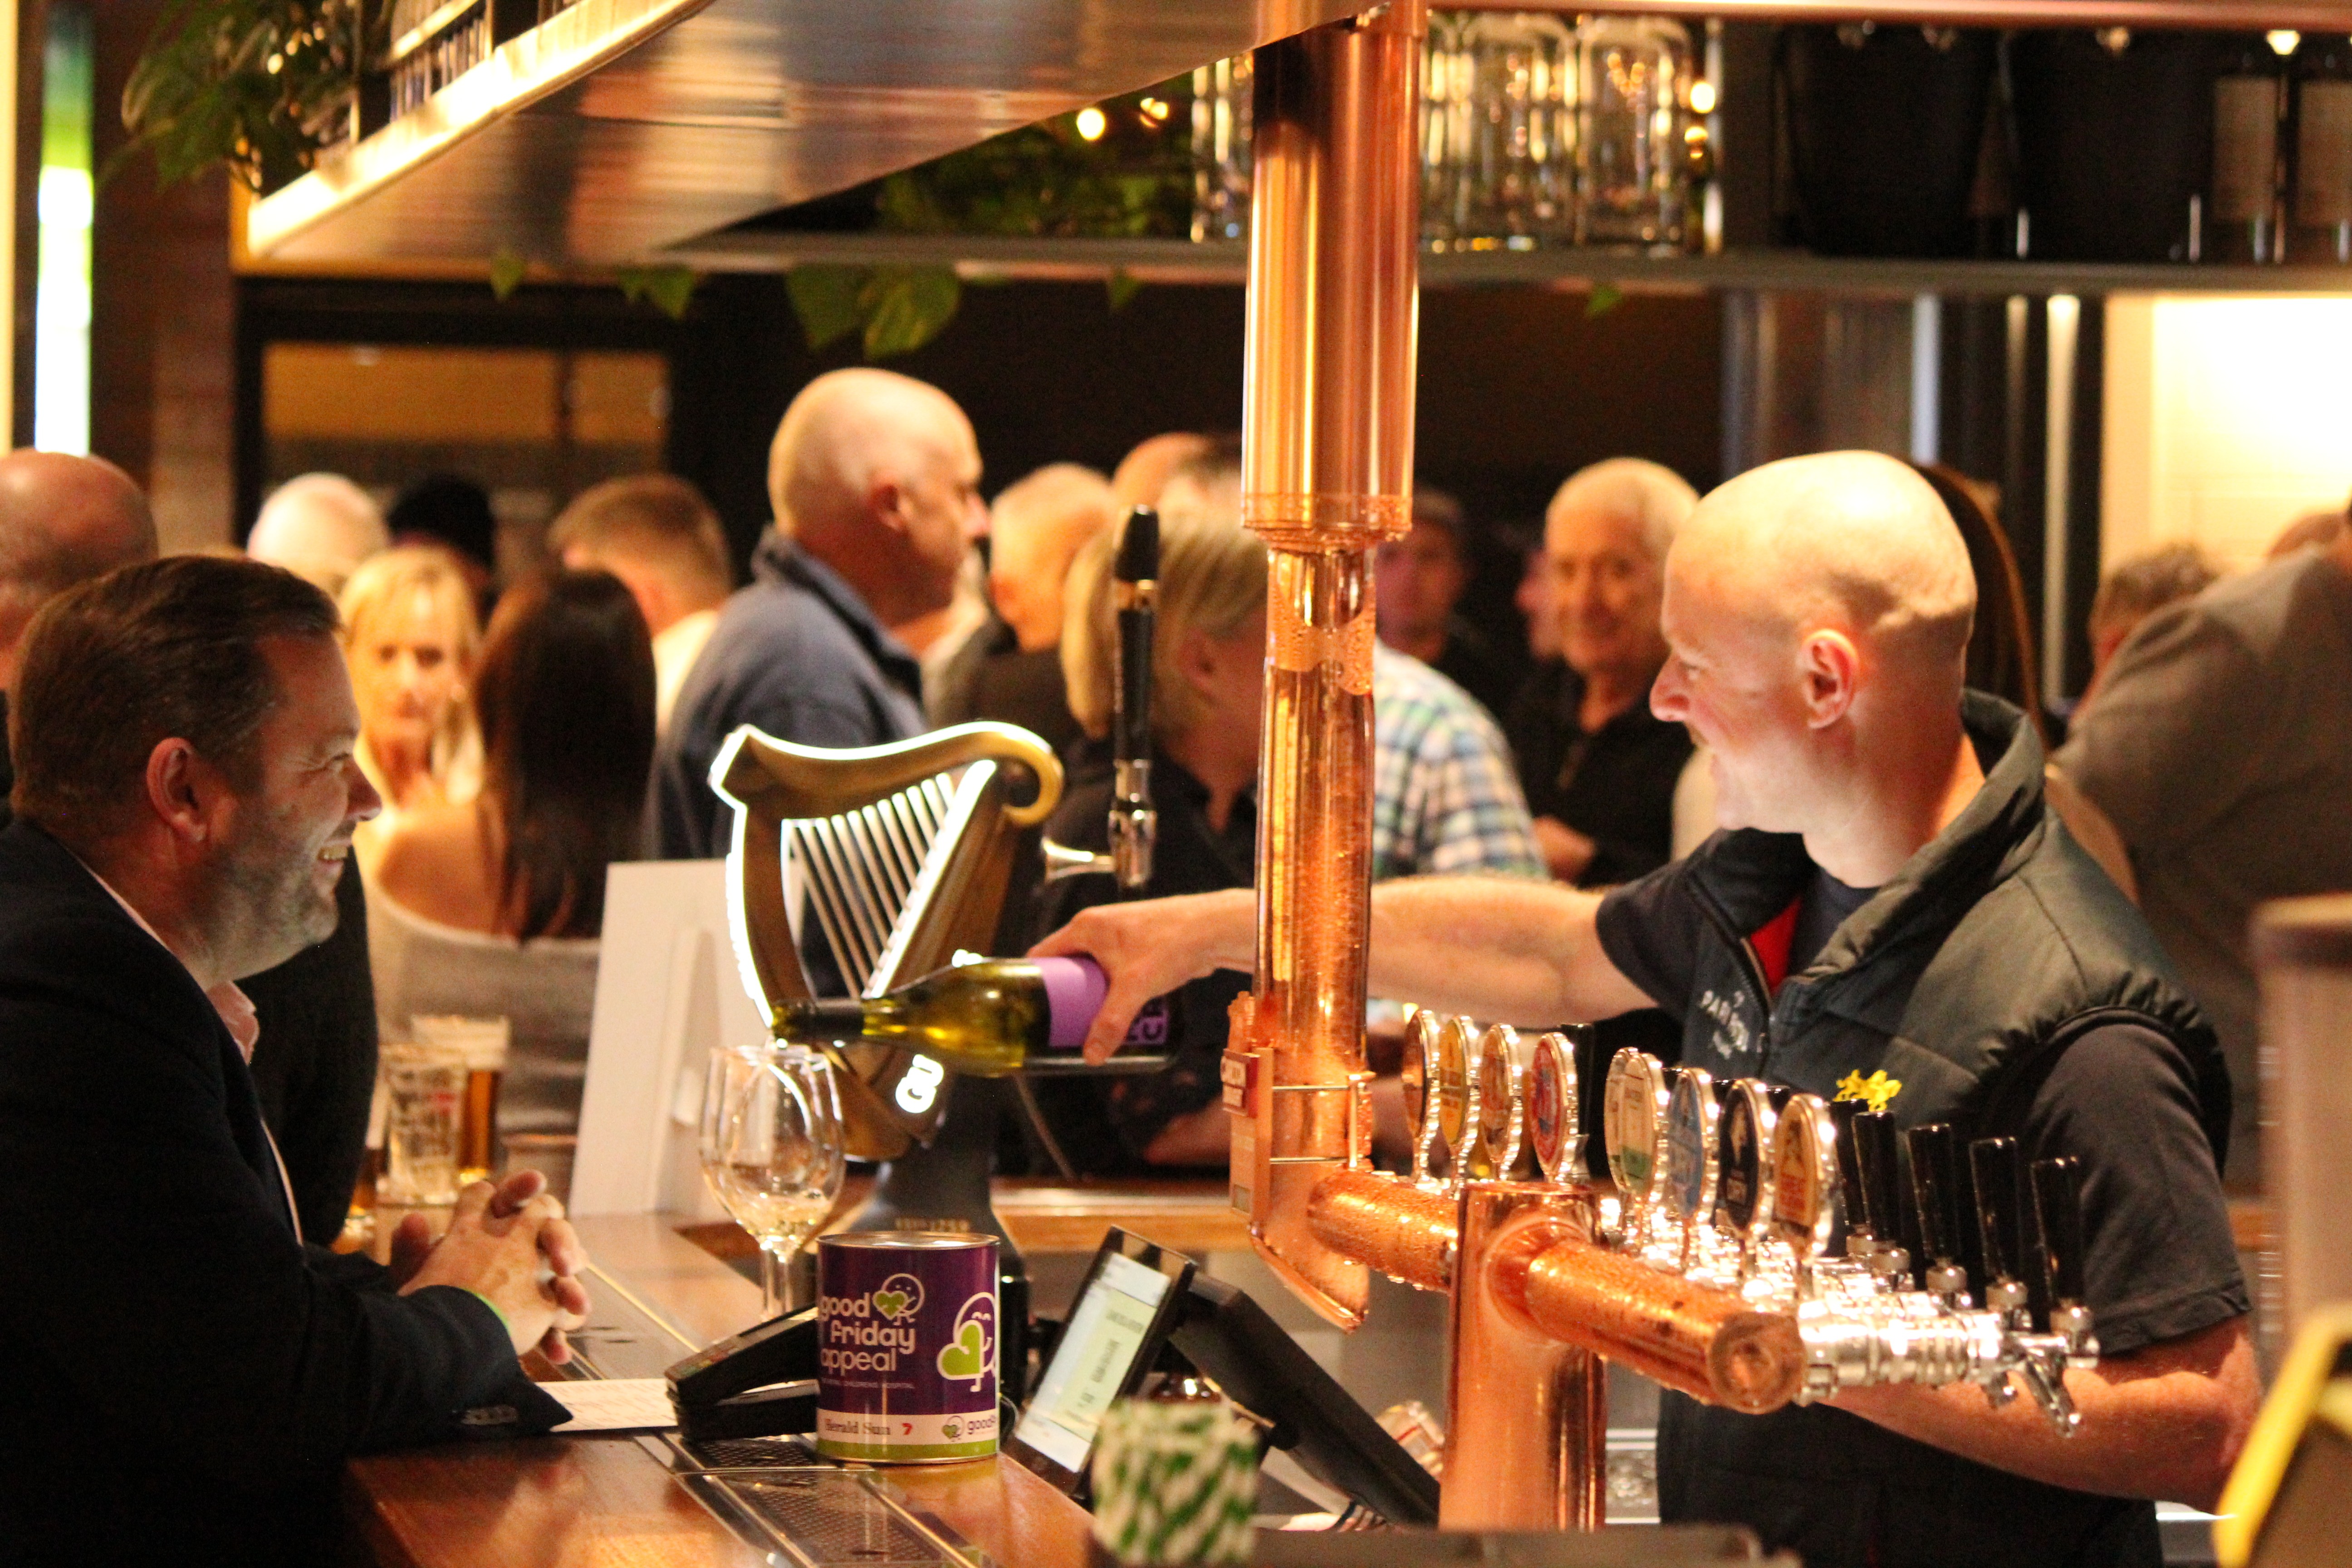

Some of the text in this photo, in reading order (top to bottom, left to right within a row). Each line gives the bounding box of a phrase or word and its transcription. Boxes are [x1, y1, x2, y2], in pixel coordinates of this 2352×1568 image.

[819, 1292, 870, 1321] good
[830, 1319, 916, 1354] friday
[820, 1348, 897, 1377] appeal
[862, 1422, 891, 1436] Sun
[902, 1422, 913, 1436] 7
